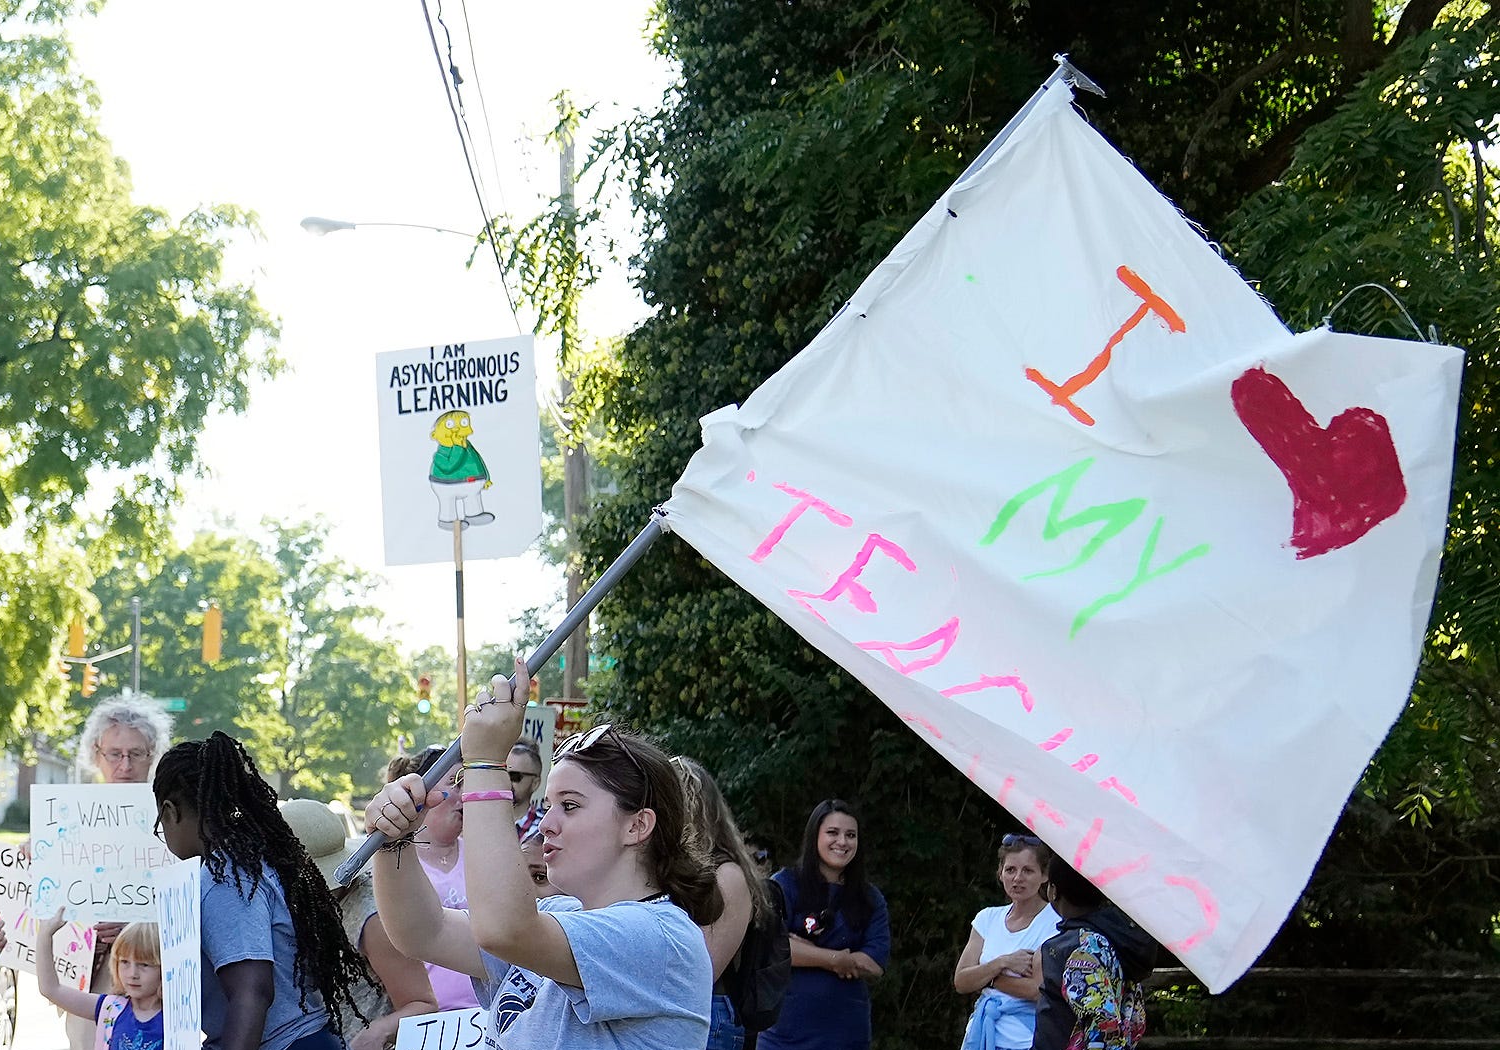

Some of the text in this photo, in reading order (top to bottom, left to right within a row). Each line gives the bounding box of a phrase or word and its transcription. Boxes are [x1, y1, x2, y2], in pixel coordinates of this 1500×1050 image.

[430, 343, 465, 360] I AM
[1025, 264, 1187, 427] I
[389, 351, 520, 388] ASYNCHRONOUS
[397, 378, 508, 415] LEARNING
[46, 798, 134, 828] I WANT
[1, 848, 32, 871] GR
[134, 847, 176, 869] HEA
[16, 941, 76, 980] TEERS
